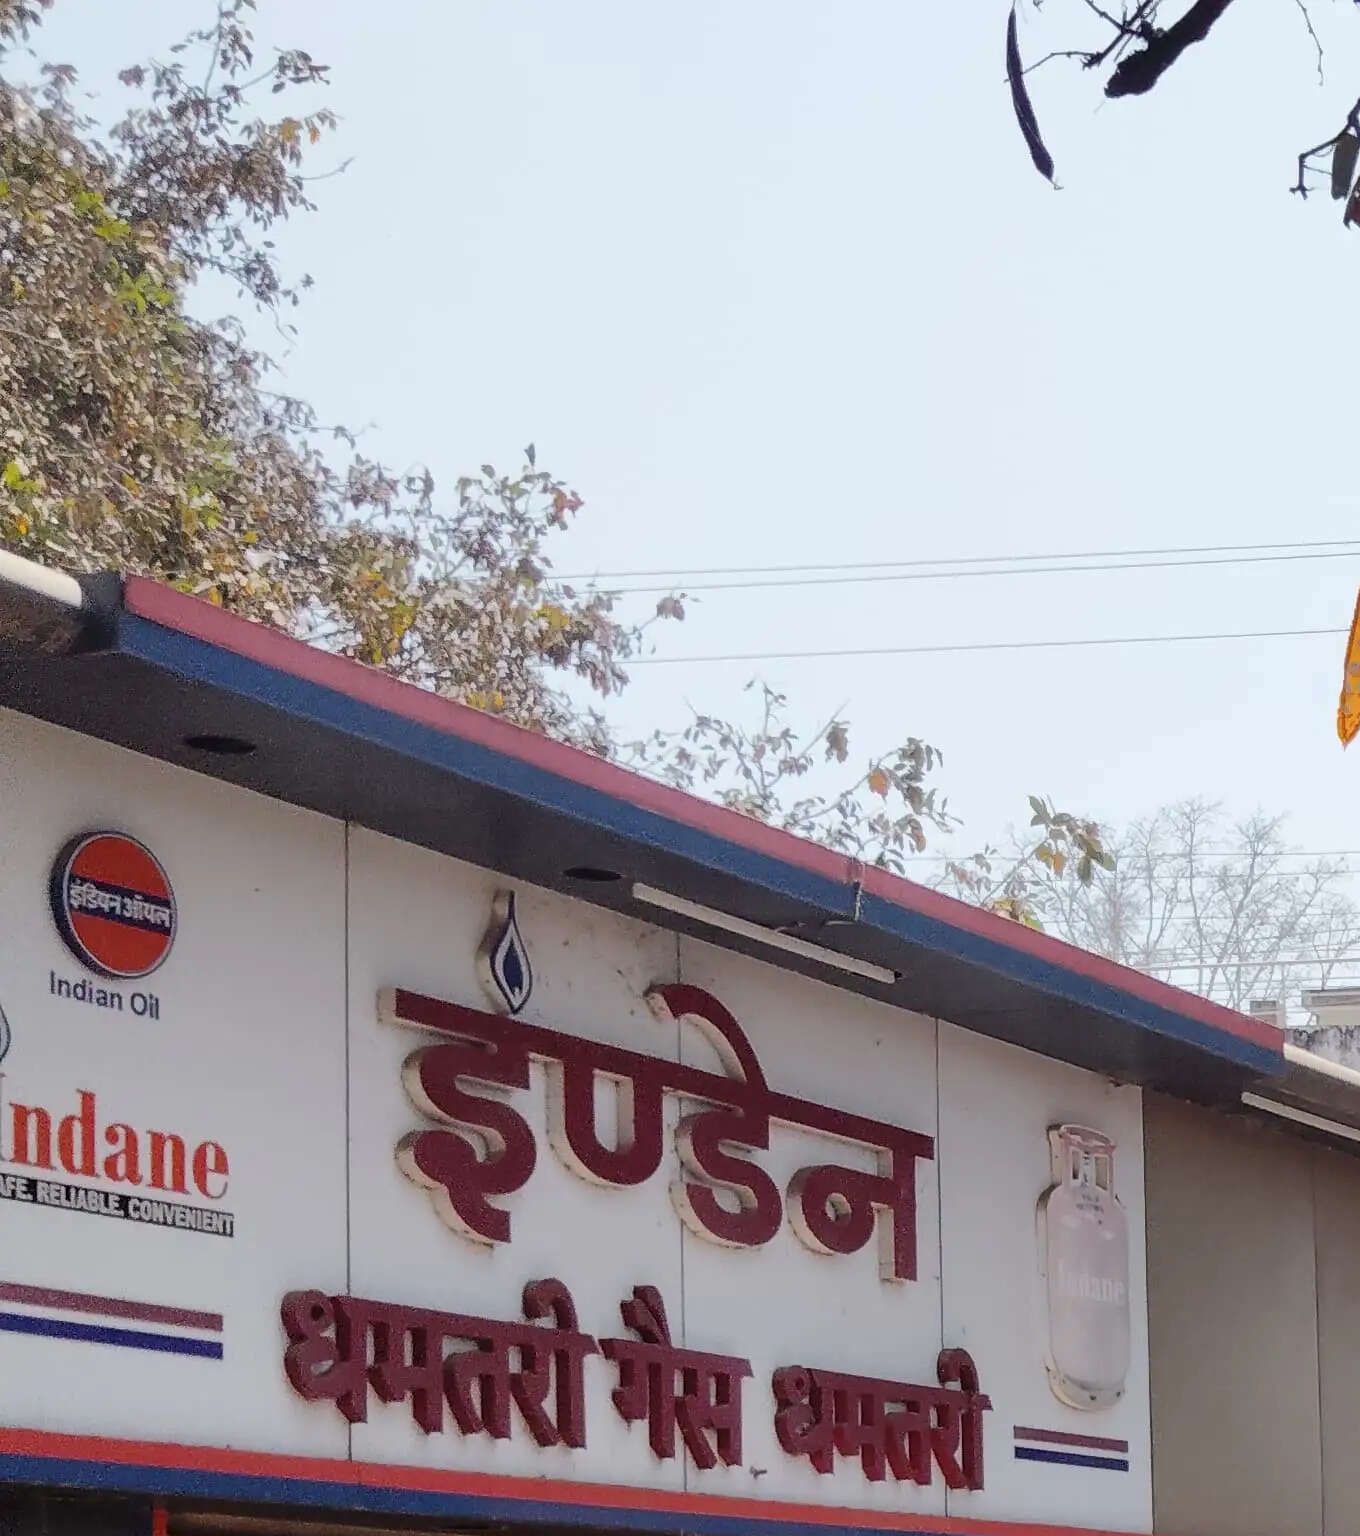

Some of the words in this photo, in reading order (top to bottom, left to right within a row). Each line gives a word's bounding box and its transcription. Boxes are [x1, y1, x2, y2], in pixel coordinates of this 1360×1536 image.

[50, 970, 123, 1011] Indian
[130, 992, 160, 1020] Oil
[0, 1073, 230, 1200] ndane
[380, 982, 936, 1284] इण्डेन
[0, 1174, 32, 1200] AFE.
[128, 1198, 234, 1236] CONVENIENT
[281, 1278, 599, 1449] धमतरी
[599, 1284, 754, 1471] गैस
[772, 1347, 993, 1491] धमतरी
